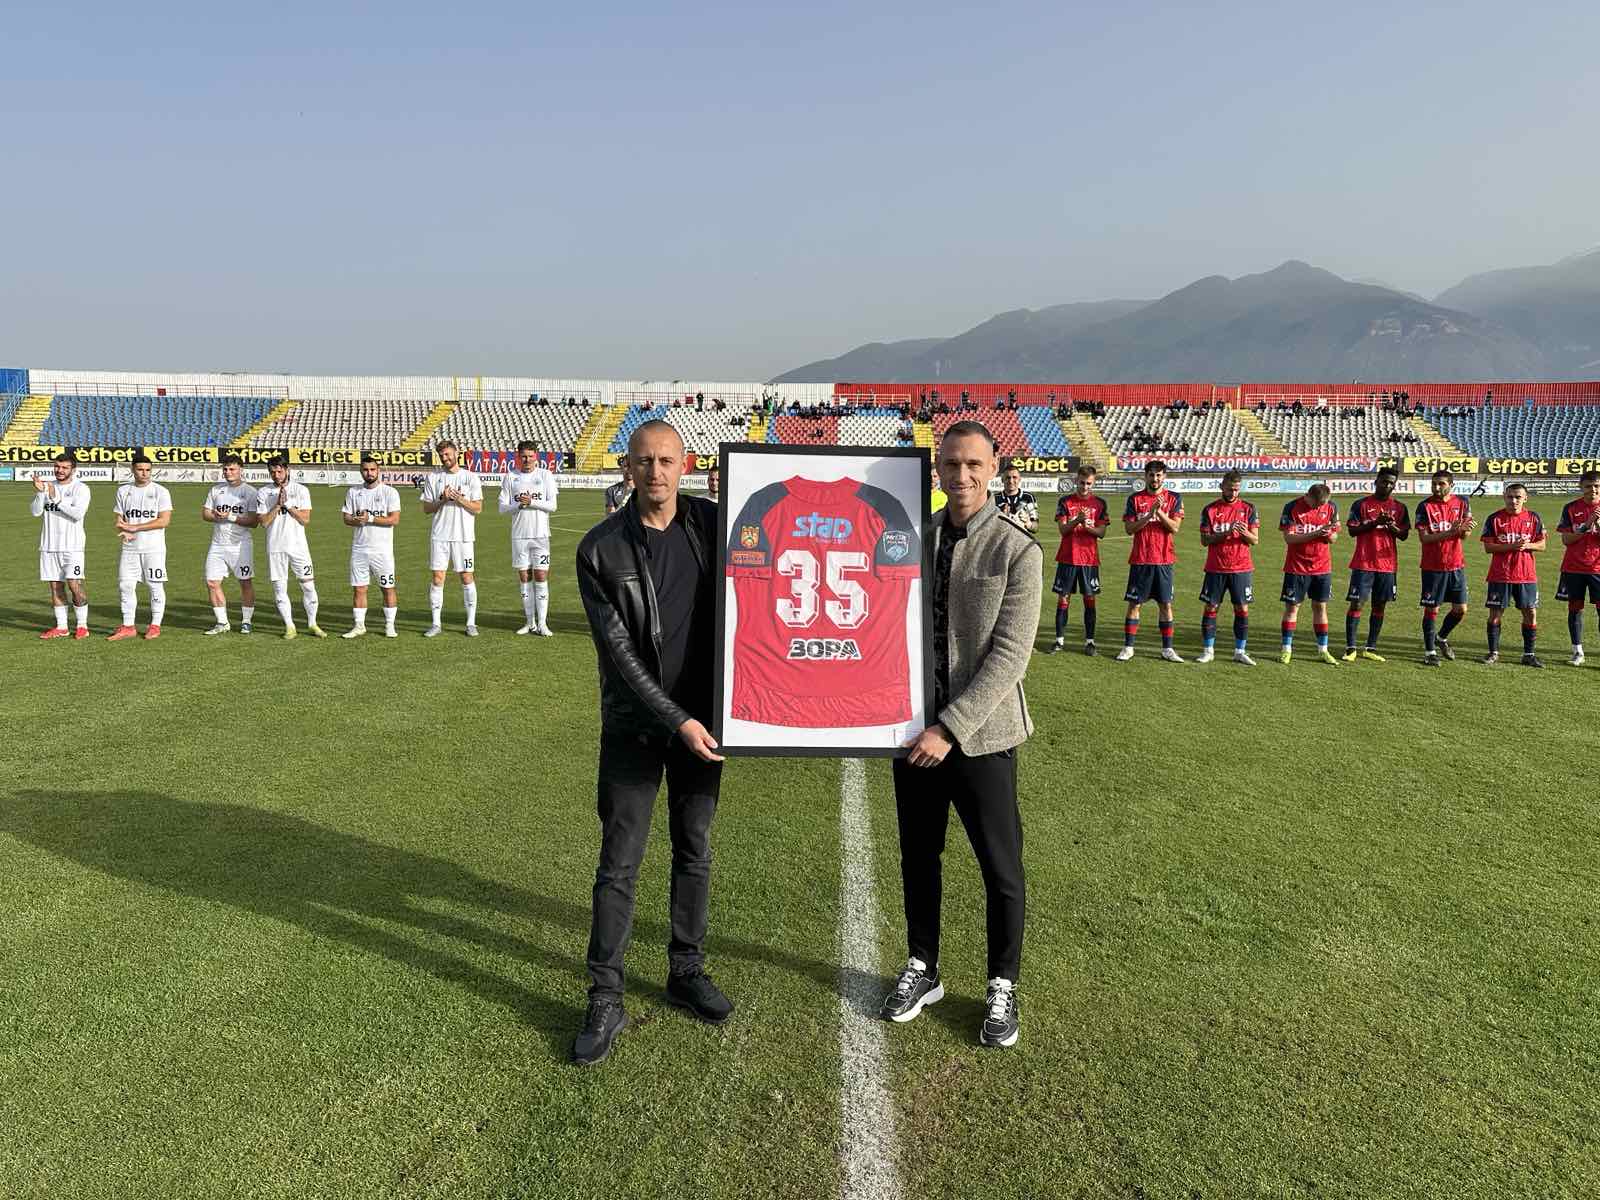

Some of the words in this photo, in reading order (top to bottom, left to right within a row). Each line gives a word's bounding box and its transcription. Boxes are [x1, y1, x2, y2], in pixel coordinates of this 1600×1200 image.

[75, 448, 136, 462] efbet
[154, 449, 211, 462] efbet
[300, 450, 353, 463] efbet
[370, 451, 425, 465] efbet
[1012, 458, 1069, 472] efbet
[1196, 458, 1215, 470] ДО
[1218, 458, 1260, 469] СОЛУН
[1272, 458, 1307, 469] САМО
[1414, 459, 1471, 472] efbet
[1488, 460, 1549, 474] efbet
[126, 509, 156, 518] efbet
[464, 559, 473, 569] 15
[74, 566, 81, 576] 8
[148, 568, 163, 579] 10
[240, 565, 251, 577] 19
[380, 575, 395, 586] 55
[776, 549, 870, 629] 35
[788, 639, 861, 659] ЗОРА
